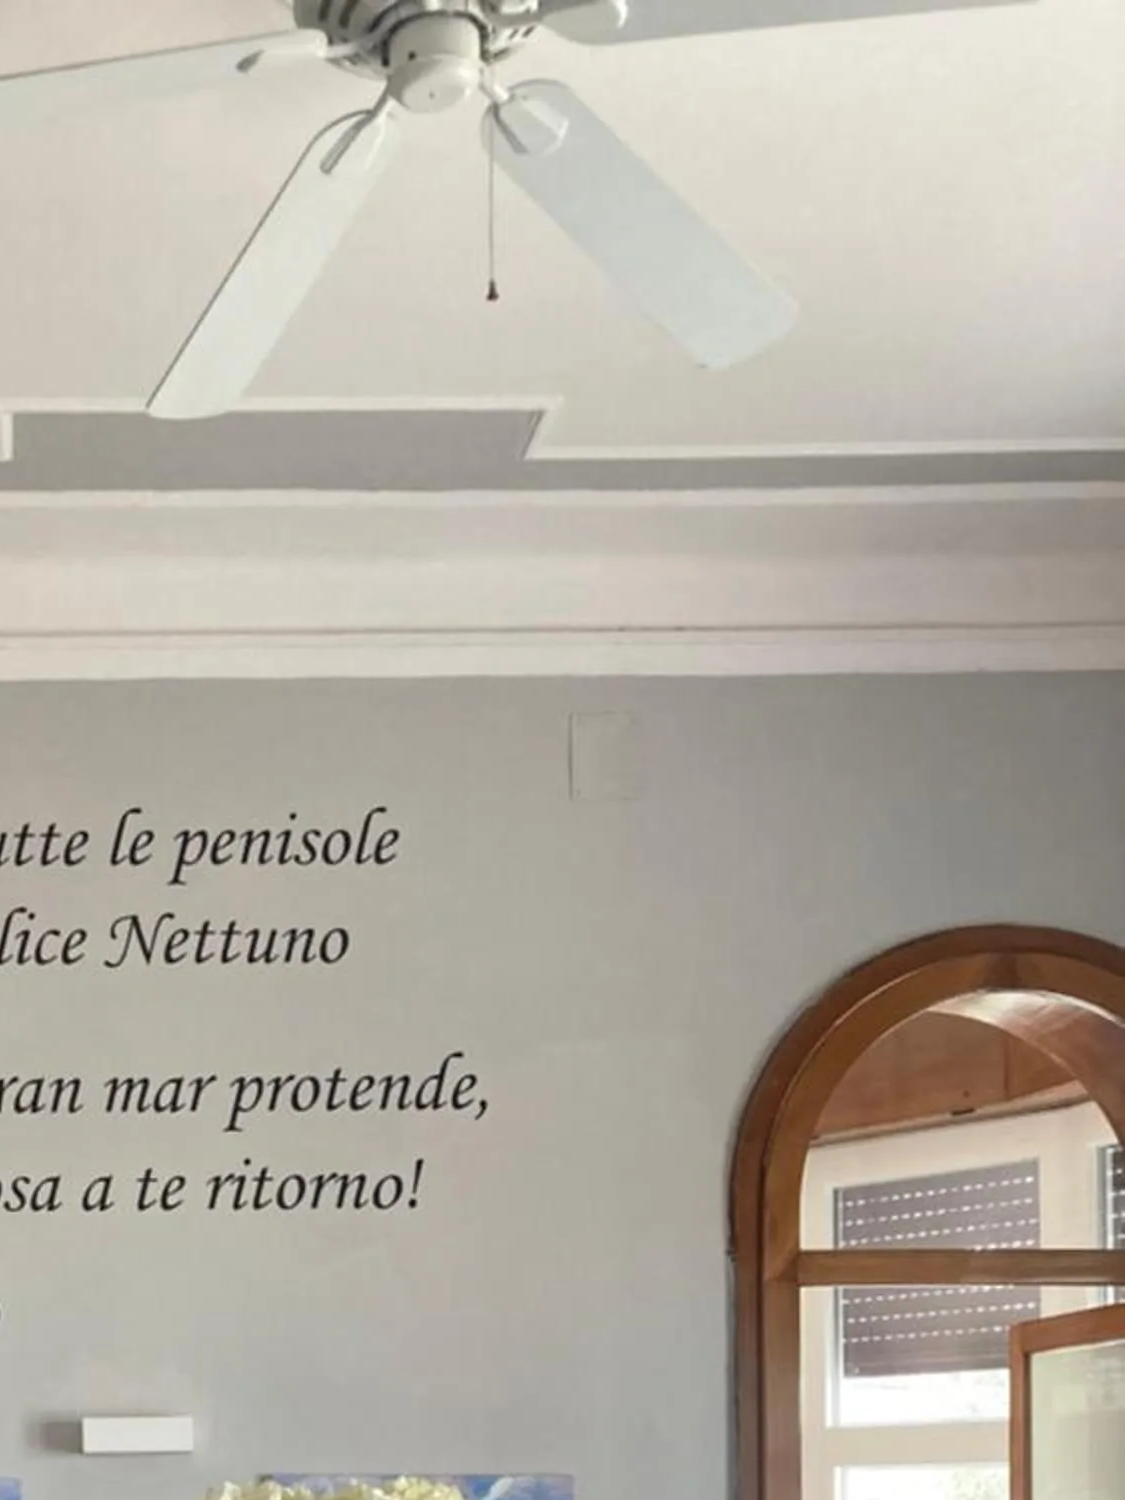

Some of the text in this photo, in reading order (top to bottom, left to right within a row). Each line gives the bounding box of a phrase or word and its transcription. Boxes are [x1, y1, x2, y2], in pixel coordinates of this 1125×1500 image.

[109, 807, 156, 867] le
[167, 805, 400, 886] penisole
[103, 911, 350, 969] Nettuno
[103, 1074, 218, 1114] mar
[223, 1051, 489, 1133] protende,
[81, 1174, 115, 1213] a
[136, 1167, 187, 1212] te
[206, 1157, 425, 1212] ritorno!
